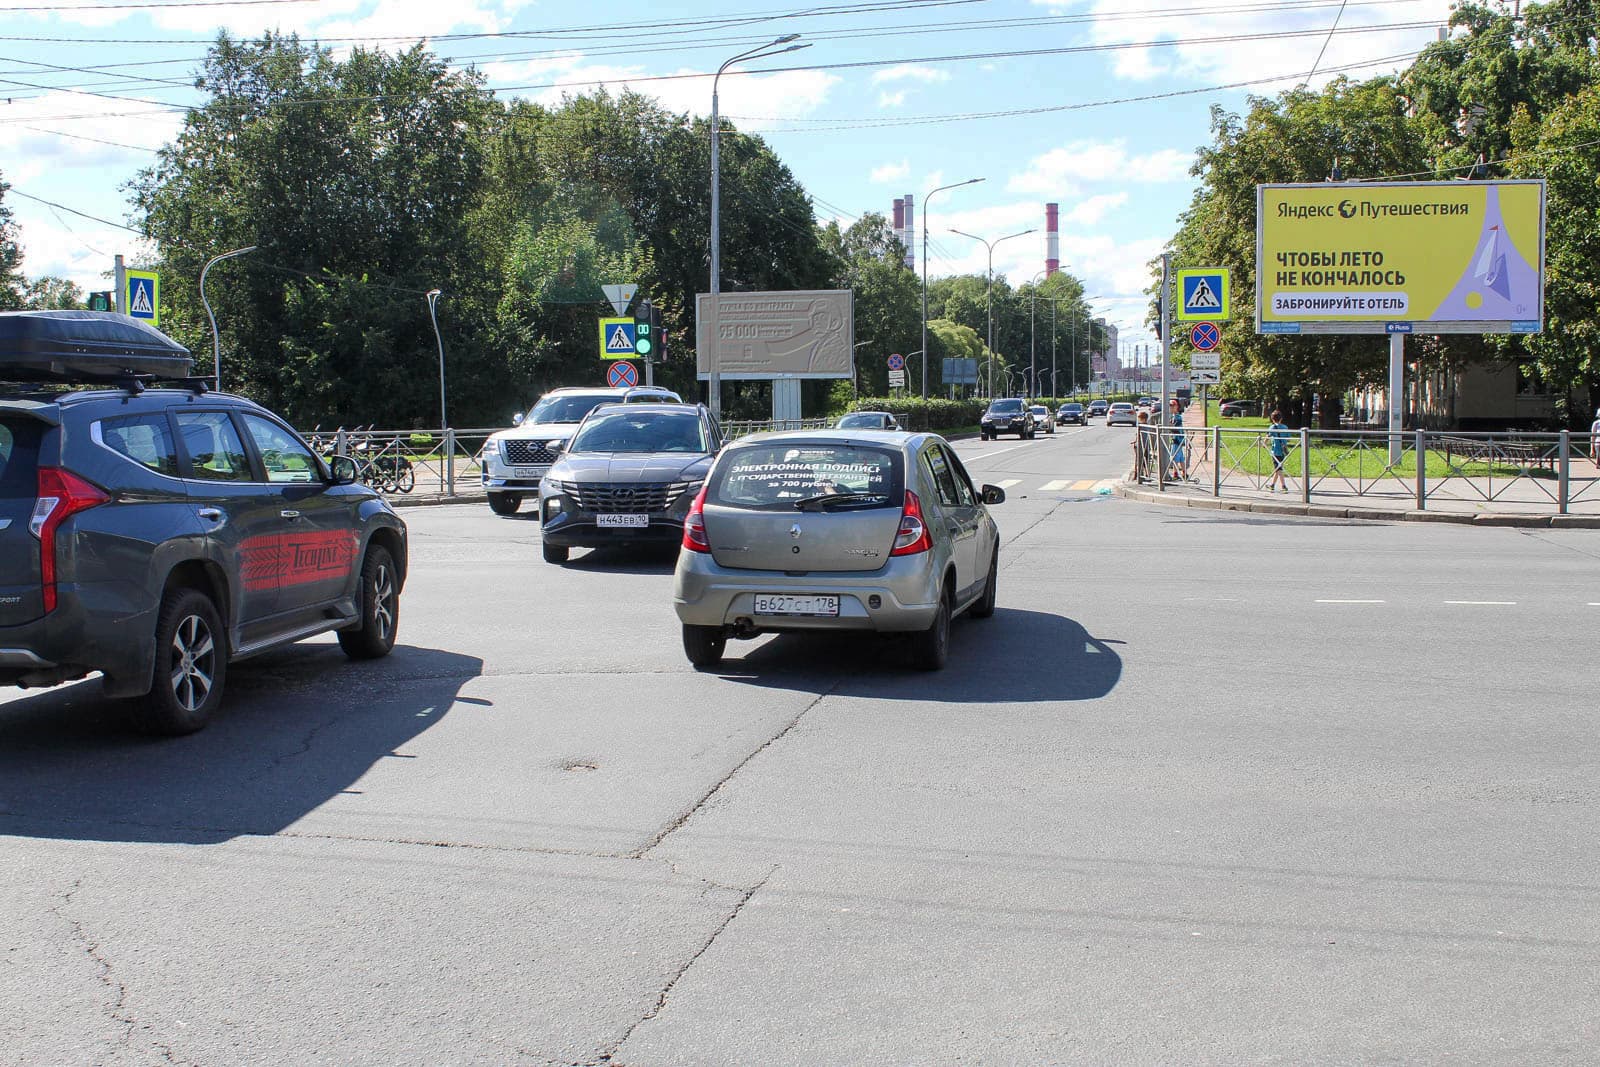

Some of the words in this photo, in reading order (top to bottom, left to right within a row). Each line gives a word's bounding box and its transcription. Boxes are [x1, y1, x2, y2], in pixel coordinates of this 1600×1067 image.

[1277, 203, 1334, 219] Яндекс
[1360, 201, 1469, 219] Путешествия
[1276, 252, 1336, 267] ЧТОБЫ
[1340, 251, 1384, 267] ЛЕТО
[1276, 271, 1298, 286] НЕ
[1301, 270, 1406, 286] КОНЧАЛОСЬ
[1276, 296, 1365, 309] ЗАБРОНИРУЙТЕ
[1367, 297, 1405, 309] ОТЕЛЬ
[731, 463, 820, 473] ЭЛЕКТРОННАЯ
[823, 463, 881, 473] ПОДПИСЬ
[815, 597, 834, 608] 178
